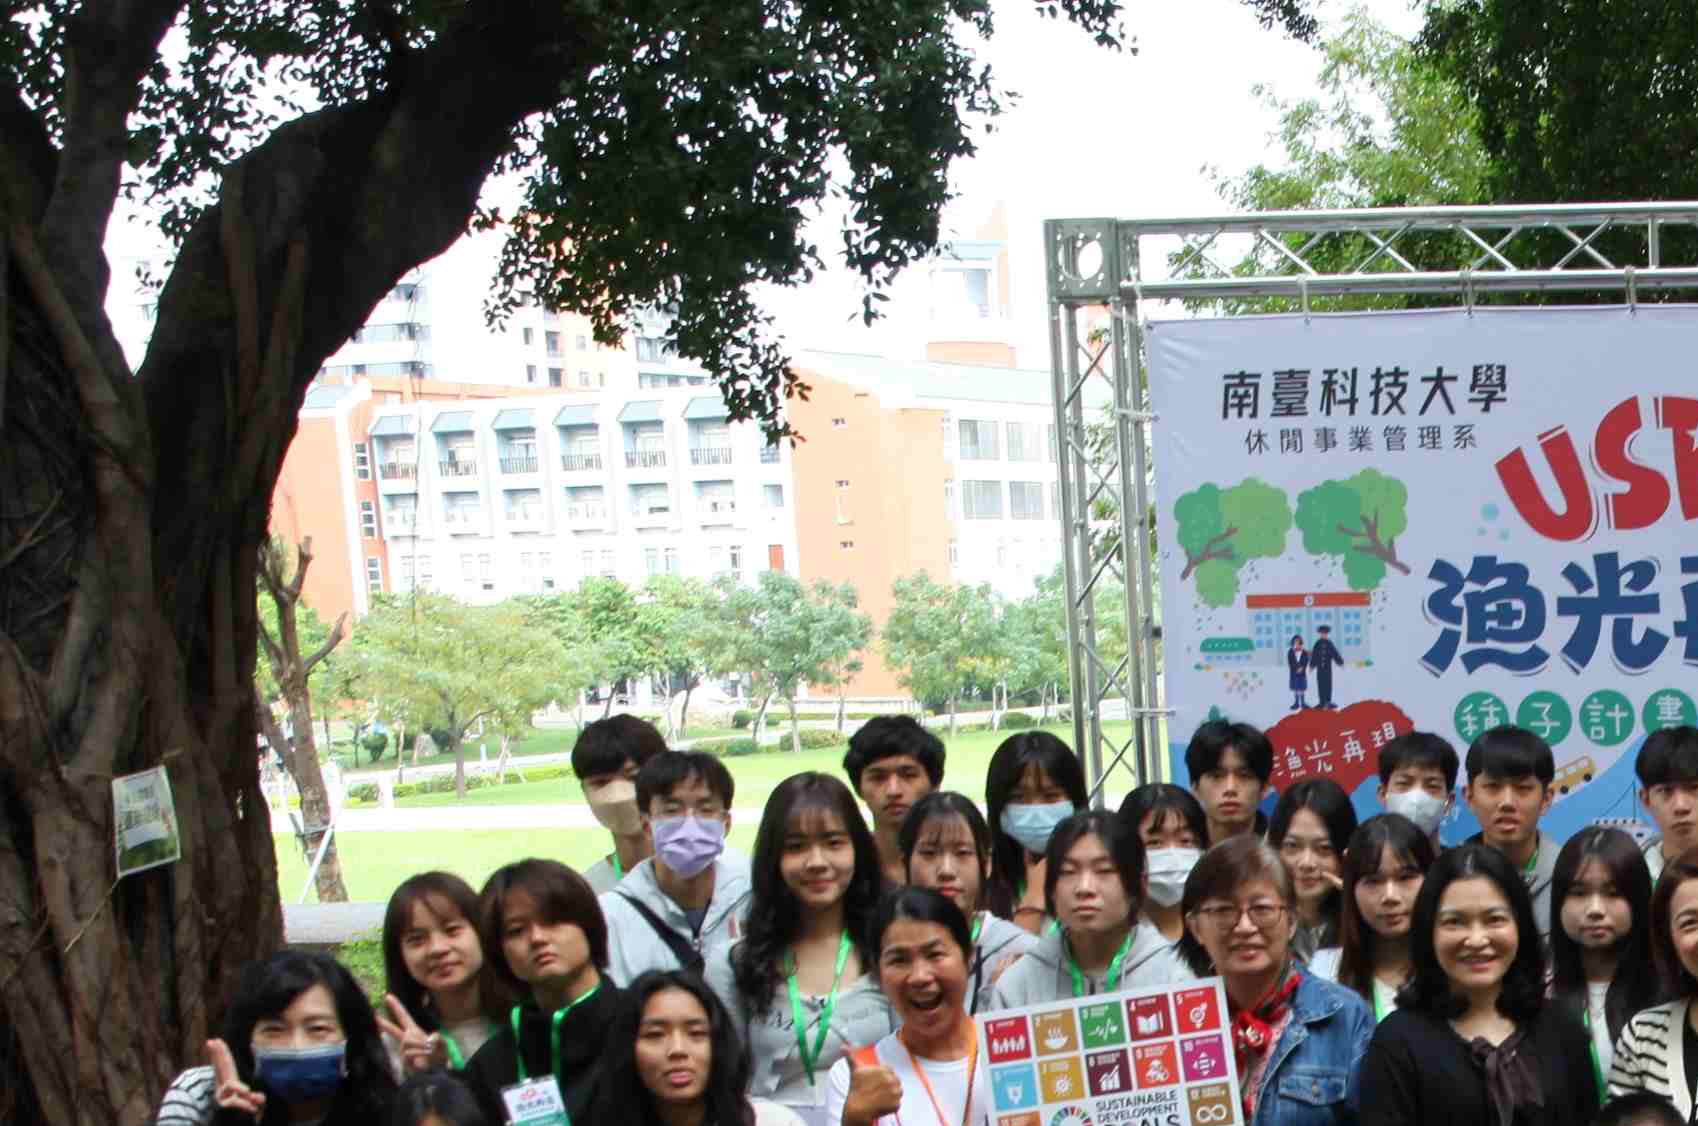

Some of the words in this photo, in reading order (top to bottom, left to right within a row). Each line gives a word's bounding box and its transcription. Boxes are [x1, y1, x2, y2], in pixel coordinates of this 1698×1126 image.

[1221, 363, 1509, 420] 南臺科技大學
[1243, 424, 1479, 456] 休閒事業管理系
[1095, 1089, 1178, 1113] SUSTAINABLE
[1097, 1102, 1179, 1124] DEVELOPMENT
